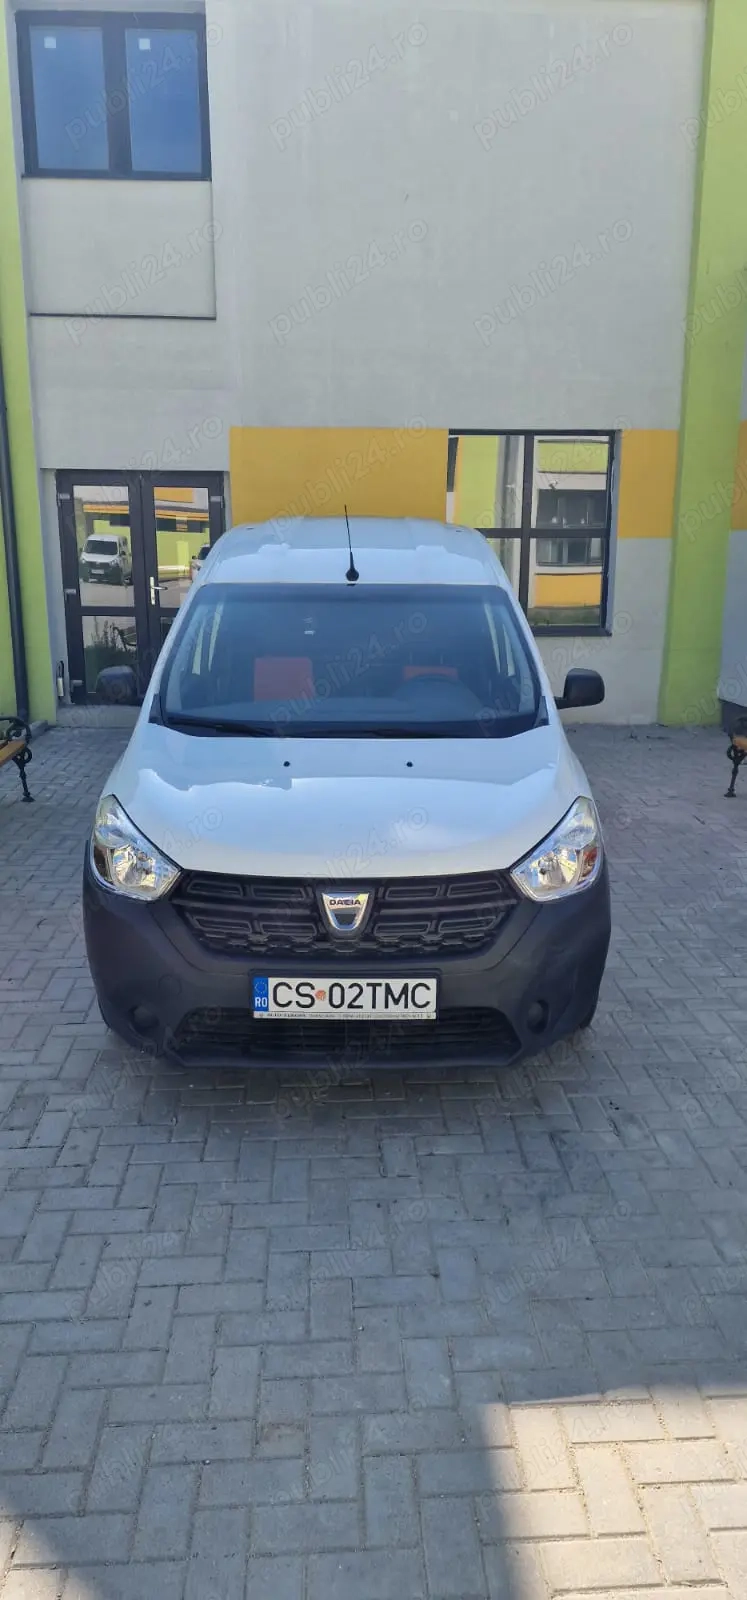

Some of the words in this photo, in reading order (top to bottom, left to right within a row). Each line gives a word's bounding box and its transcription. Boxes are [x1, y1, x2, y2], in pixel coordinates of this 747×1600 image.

[254, 996, 268, 1008] RO
[272, 981, 316, 1009] CS
[328, 982, 431, 1009] 02TMC
